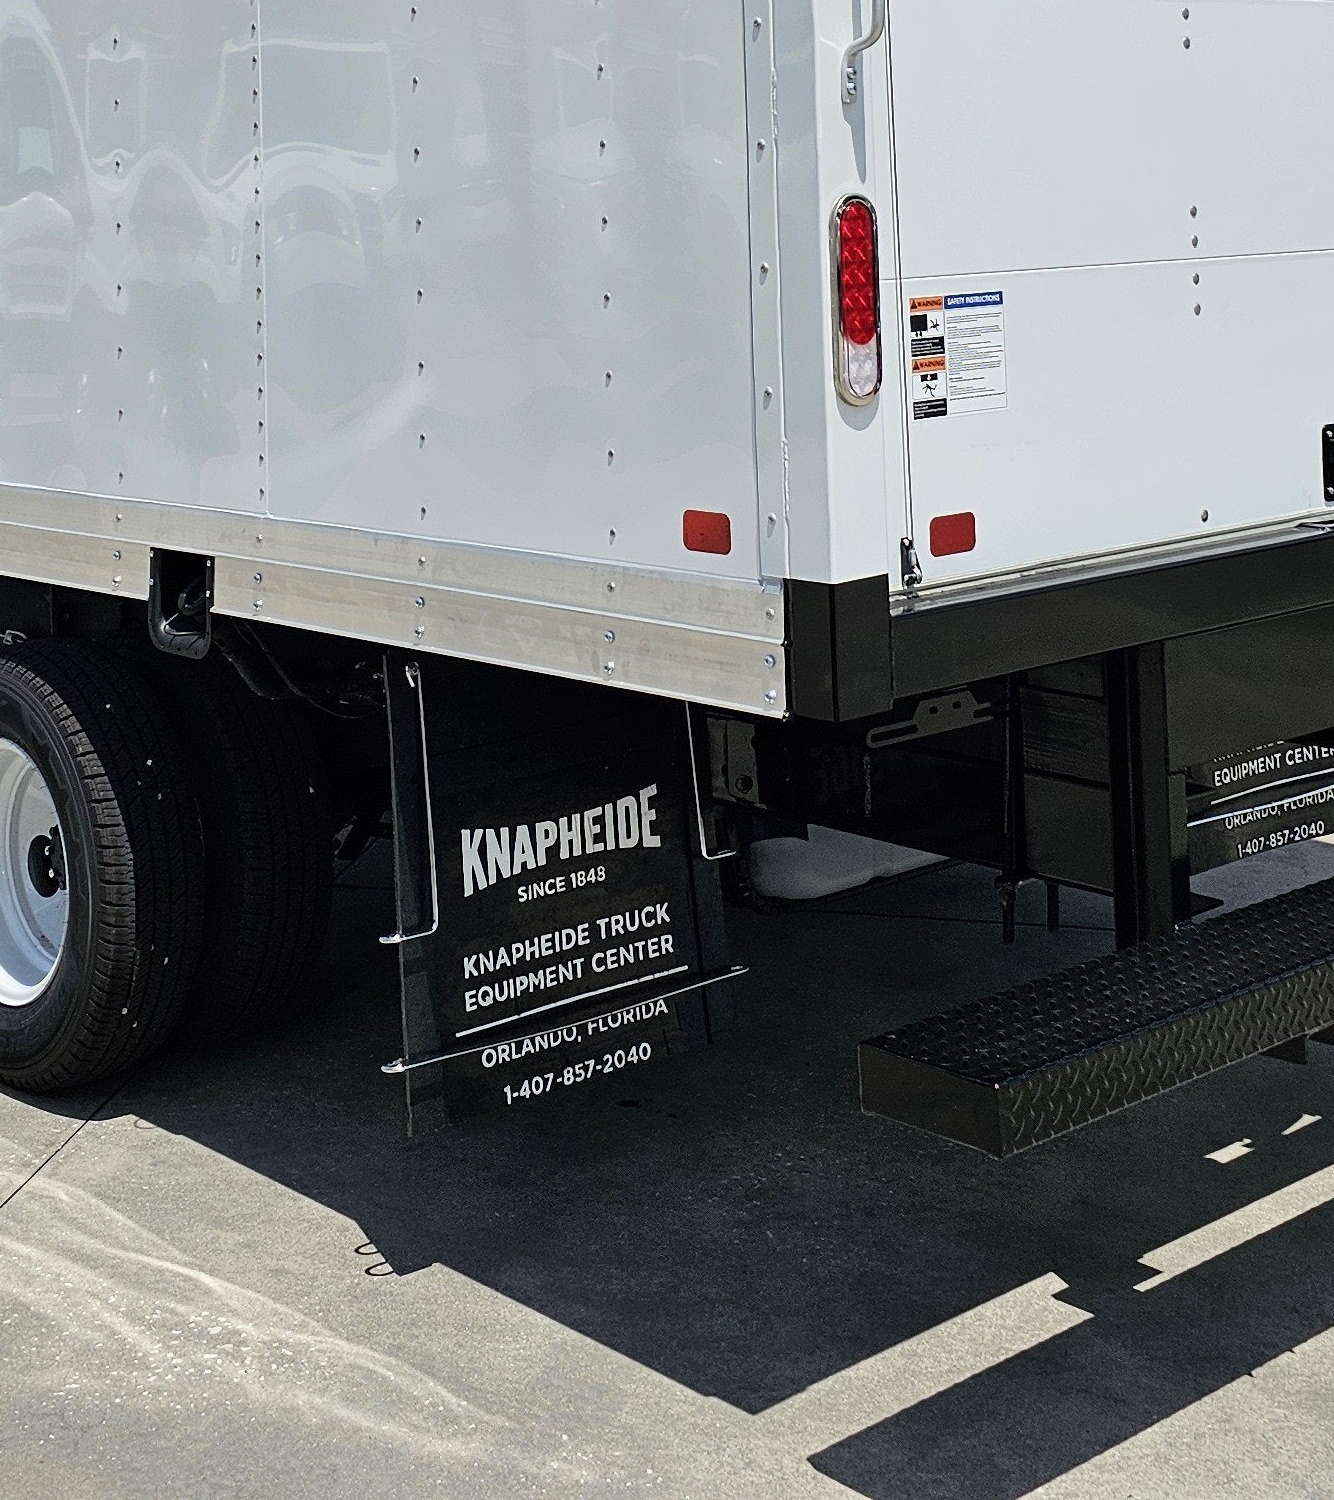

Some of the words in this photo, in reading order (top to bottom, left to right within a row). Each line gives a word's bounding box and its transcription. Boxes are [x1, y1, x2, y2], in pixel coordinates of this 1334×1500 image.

[1214, 753, 1281, 786] EQUIPMENT
[1283, 789, 1334, 811] FLORIDA
[461, 783, 661, 897] KNAPHEIDE
[1237, 821, 1325, 858] 1-407-857-2040
[518, 876, 566, 902] SINCE
[570, 866, 606, 888] 1848
[463, 923, 590, 979] KNAPHEIDE
[596, 902, 671, 939] TRUCK
[464, 958, 585, 1012] EQUIPMENT
[591, 934, 674, 972] CENTER
[481, 1026, 582, 1068] ORLANDO,
[588, 999, 668, 1035] FLORIDA
[503, 1042, 652, 1105] 1-407-857-2040
